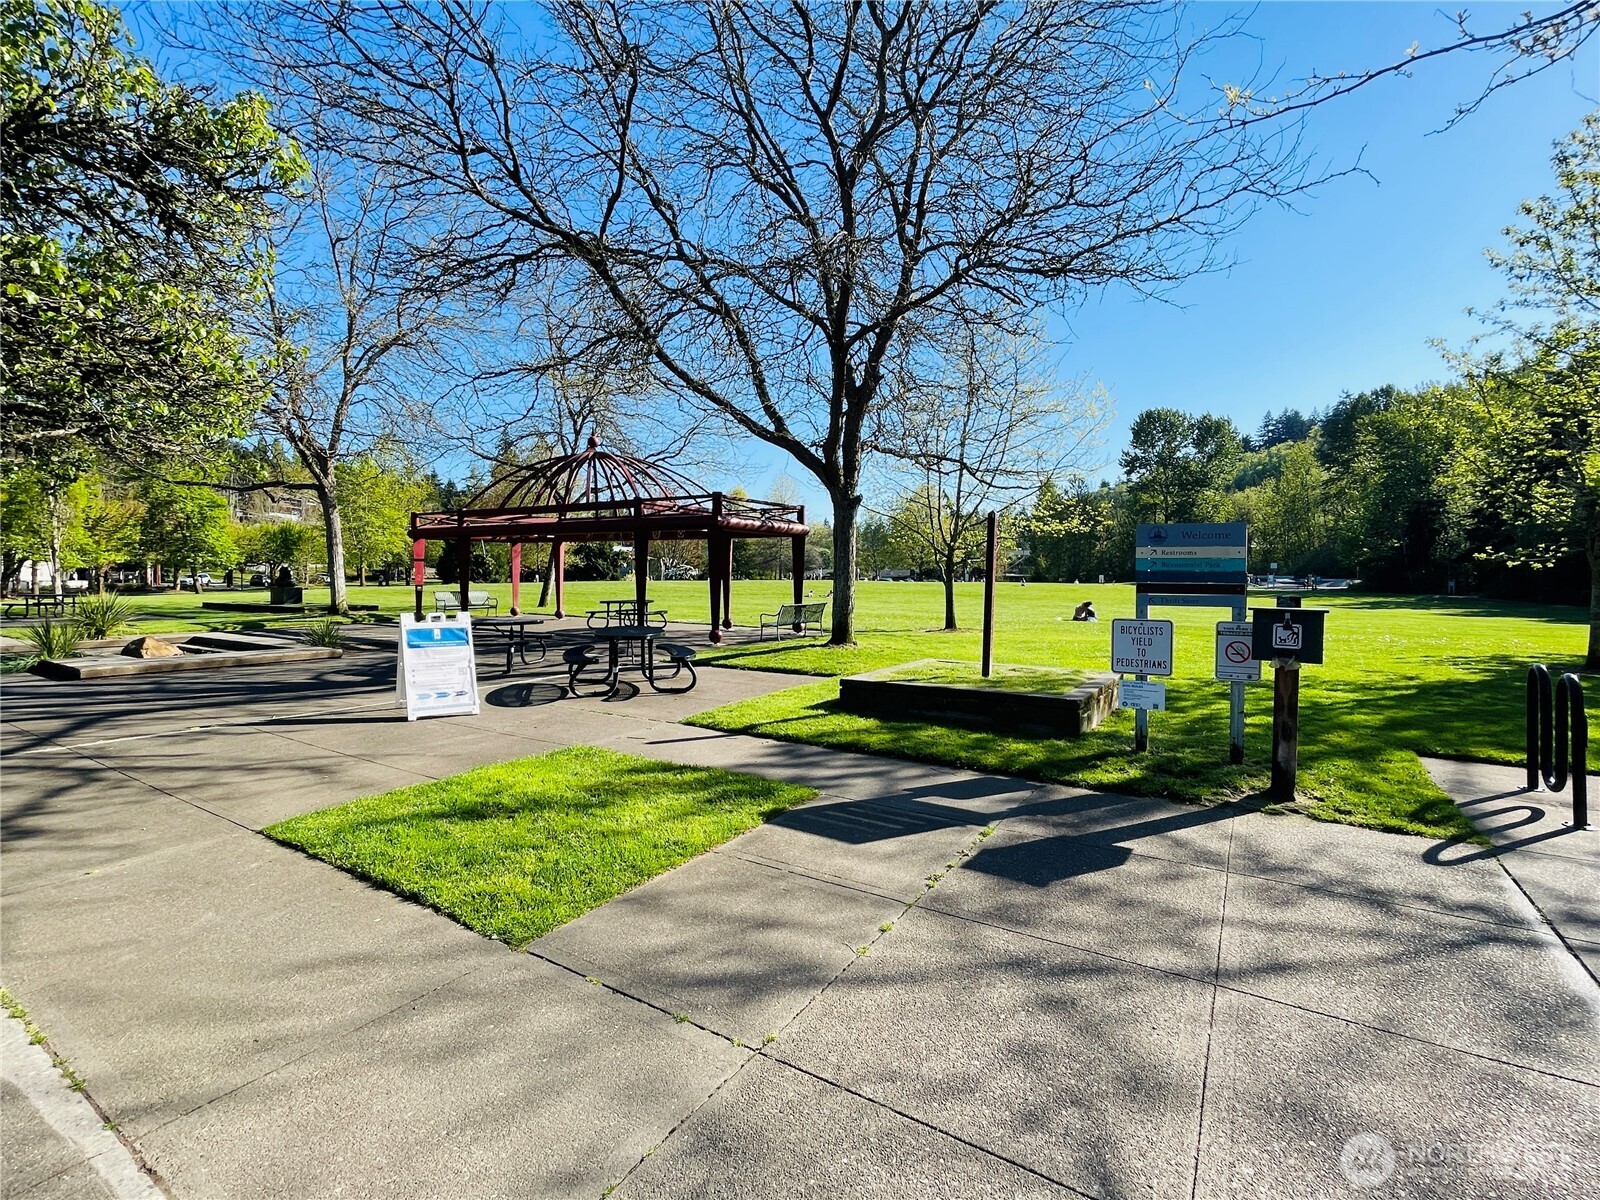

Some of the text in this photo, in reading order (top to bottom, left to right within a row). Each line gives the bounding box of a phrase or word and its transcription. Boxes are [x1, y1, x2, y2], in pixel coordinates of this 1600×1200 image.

[1181, 530, 1232, 540] Welcome
[1120, 625, 1164, 636] BICYCLISTS
[1130, 637, 1153, 647] YIELD
[1136, 648, 1146, 657] TO
[1116, 658, 1167, 670] PEDESTRIANS
